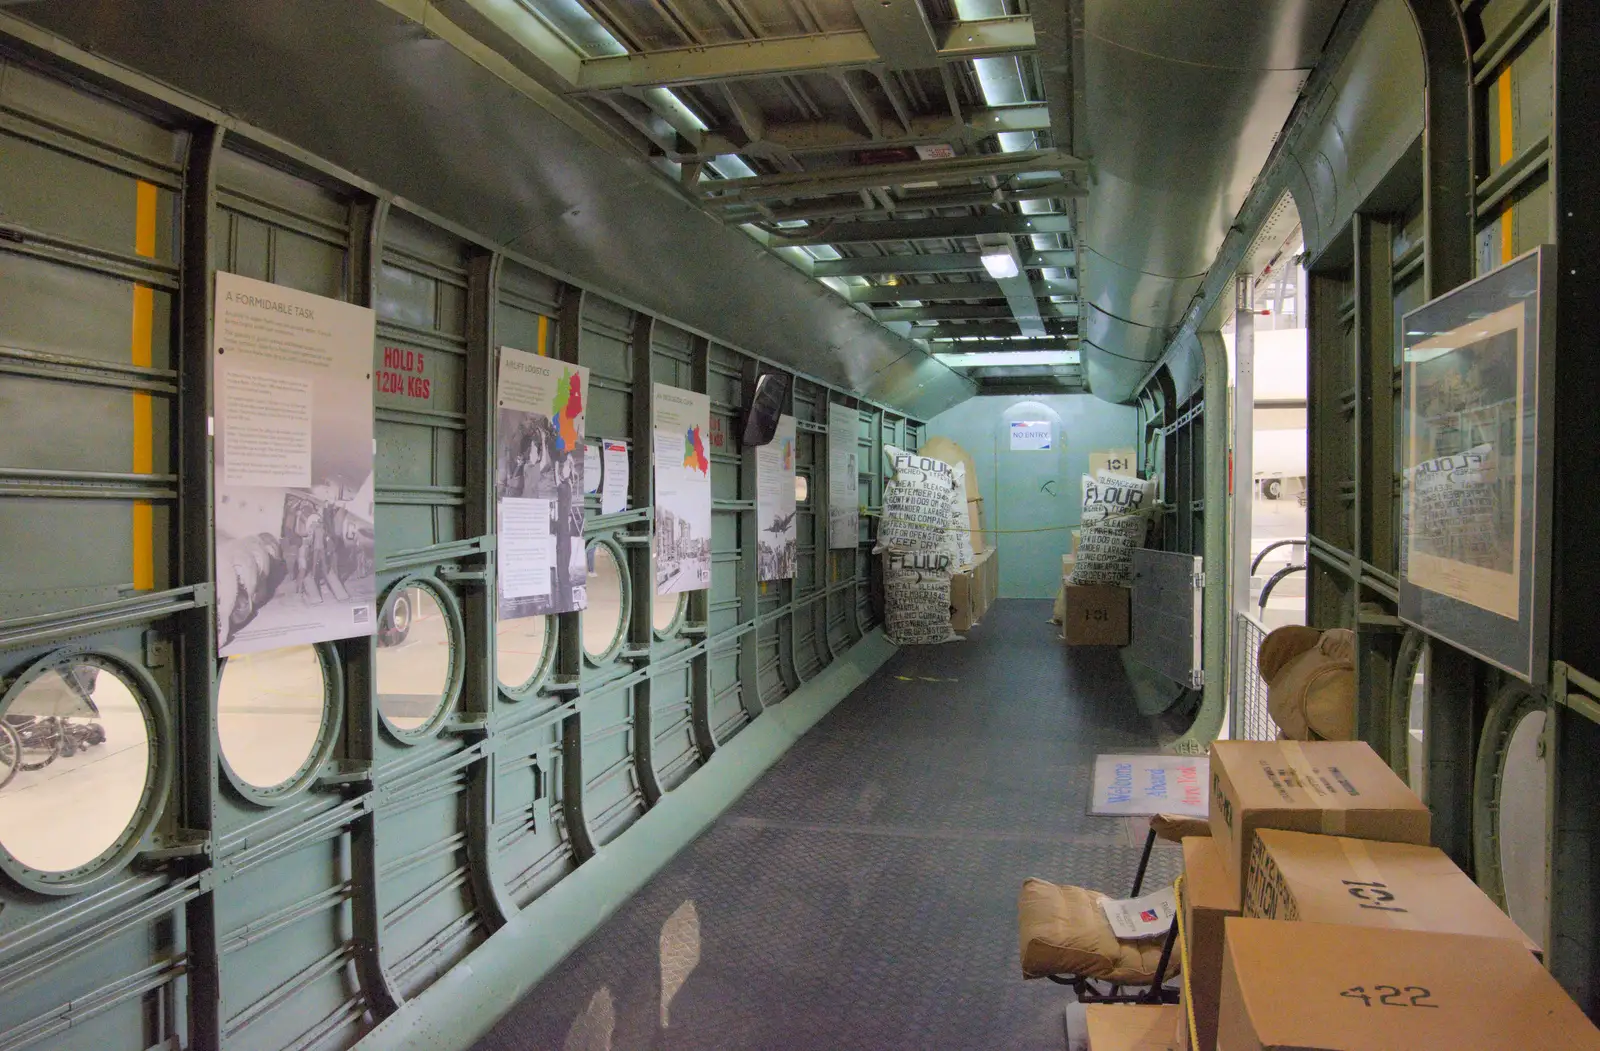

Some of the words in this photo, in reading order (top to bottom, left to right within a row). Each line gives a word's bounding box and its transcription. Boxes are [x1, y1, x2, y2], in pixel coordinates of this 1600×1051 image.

[226, 291, 233, 301] A
[235, 293, 293, 316] FORMIDABLE
[294, 306, 315, 320] TASK
[384, 347, 413, 371] HOLD
[416, 352, 424, 374] 5
[375, 370, 403, 394] 1204
[407, 376, 430, 399] KGS
[1012, 431, 1024, 439] NO
[1024, 431, 1049, 440] ENTRY
[1084, 485, 1144, 509] FLOUR
[889, 536, 918, 548] KEEP
[919, 540, 940, 550] DRY
[1107, 763, 1132, 803] Welcome
[1144, 768, 1167, 798] Aboard
[1339, 984, 1439, 1008] 422
